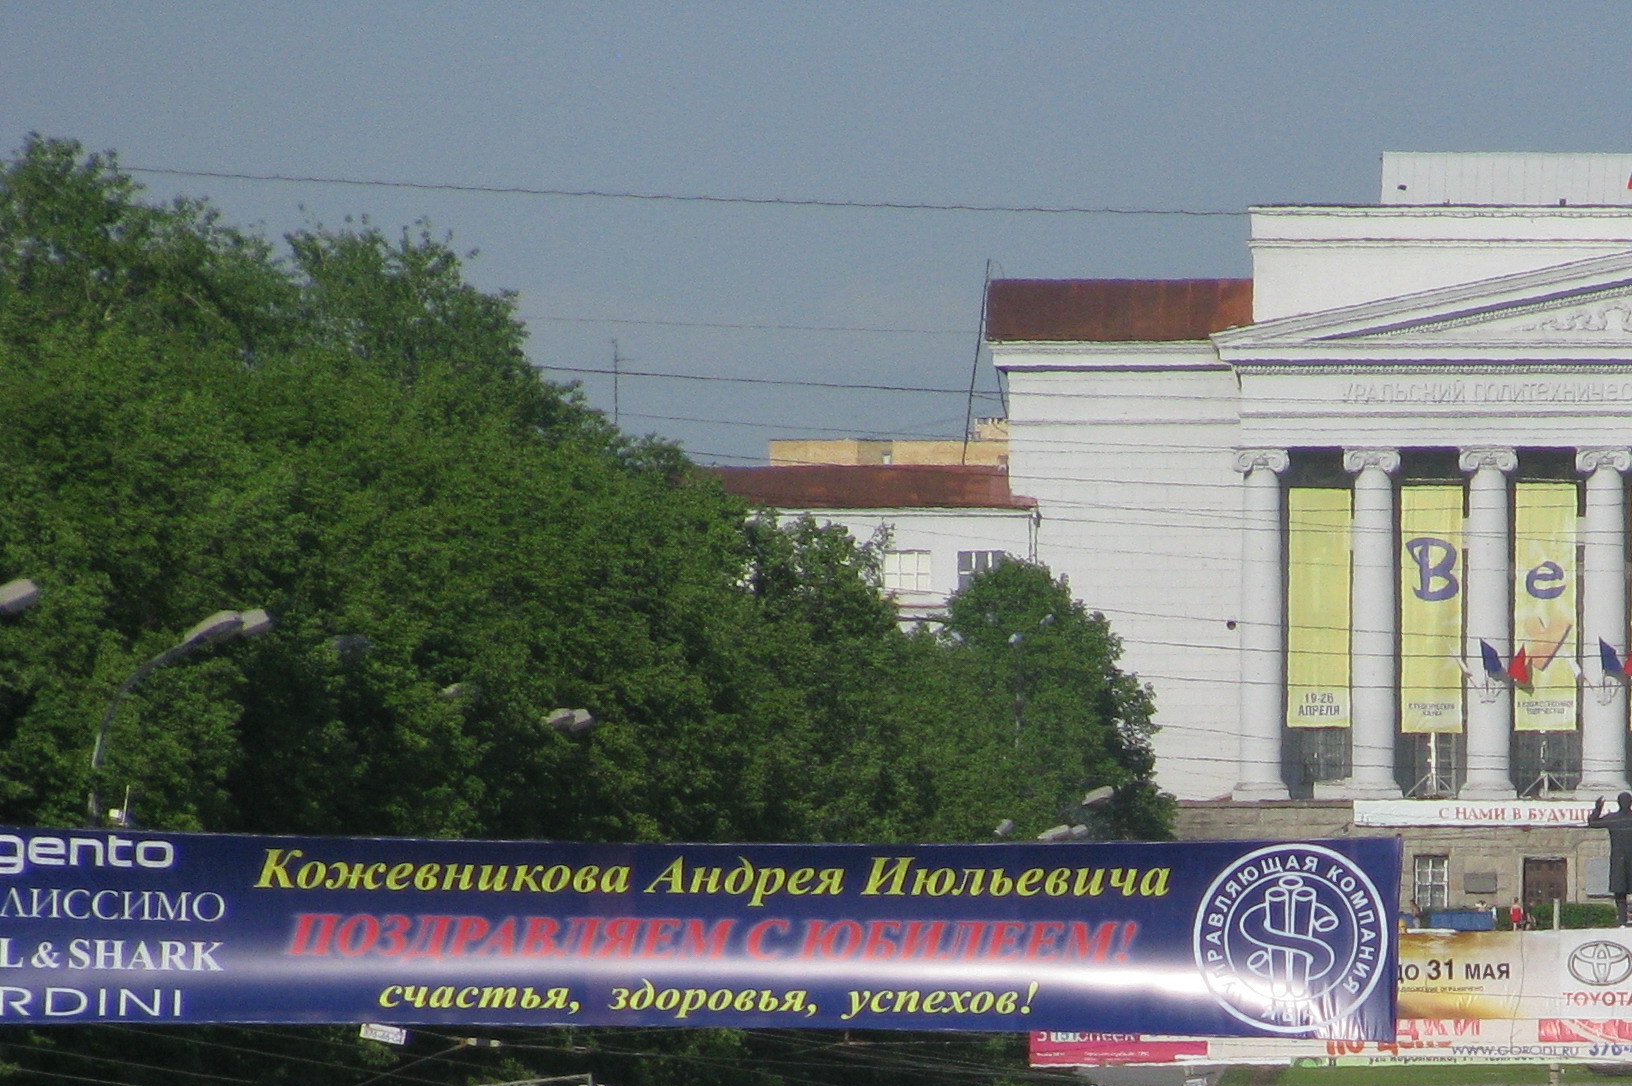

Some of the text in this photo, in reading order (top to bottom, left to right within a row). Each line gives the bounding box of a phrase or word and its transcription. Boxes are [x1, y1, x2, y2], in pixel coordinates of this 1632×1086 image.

[1298, 704, 1341, 717] АПРЕЛЯ
[1455, 806, 1506, 820] НАМИ
[253, 847, 1172, 908] Кожевникова Андрея Июльевича
[1, 887, 226, 923] ЛИССИМО
[286, 913, 1139, 964] ПОЗДРАВЛЯЕМ С ЮБИЛЕЕМ!
[1325, 864, 1377, 995] КОМПАНИЯ
[68, 938, 225, 972] SHARK
[1427, 958, 1454, 981] 31
[1464, 962, 1510, 981] МАЯ
[0, 986, 182, 1017] RDINI
[377, 977, 1040, 1021] счастья, здоровья, успехов!
